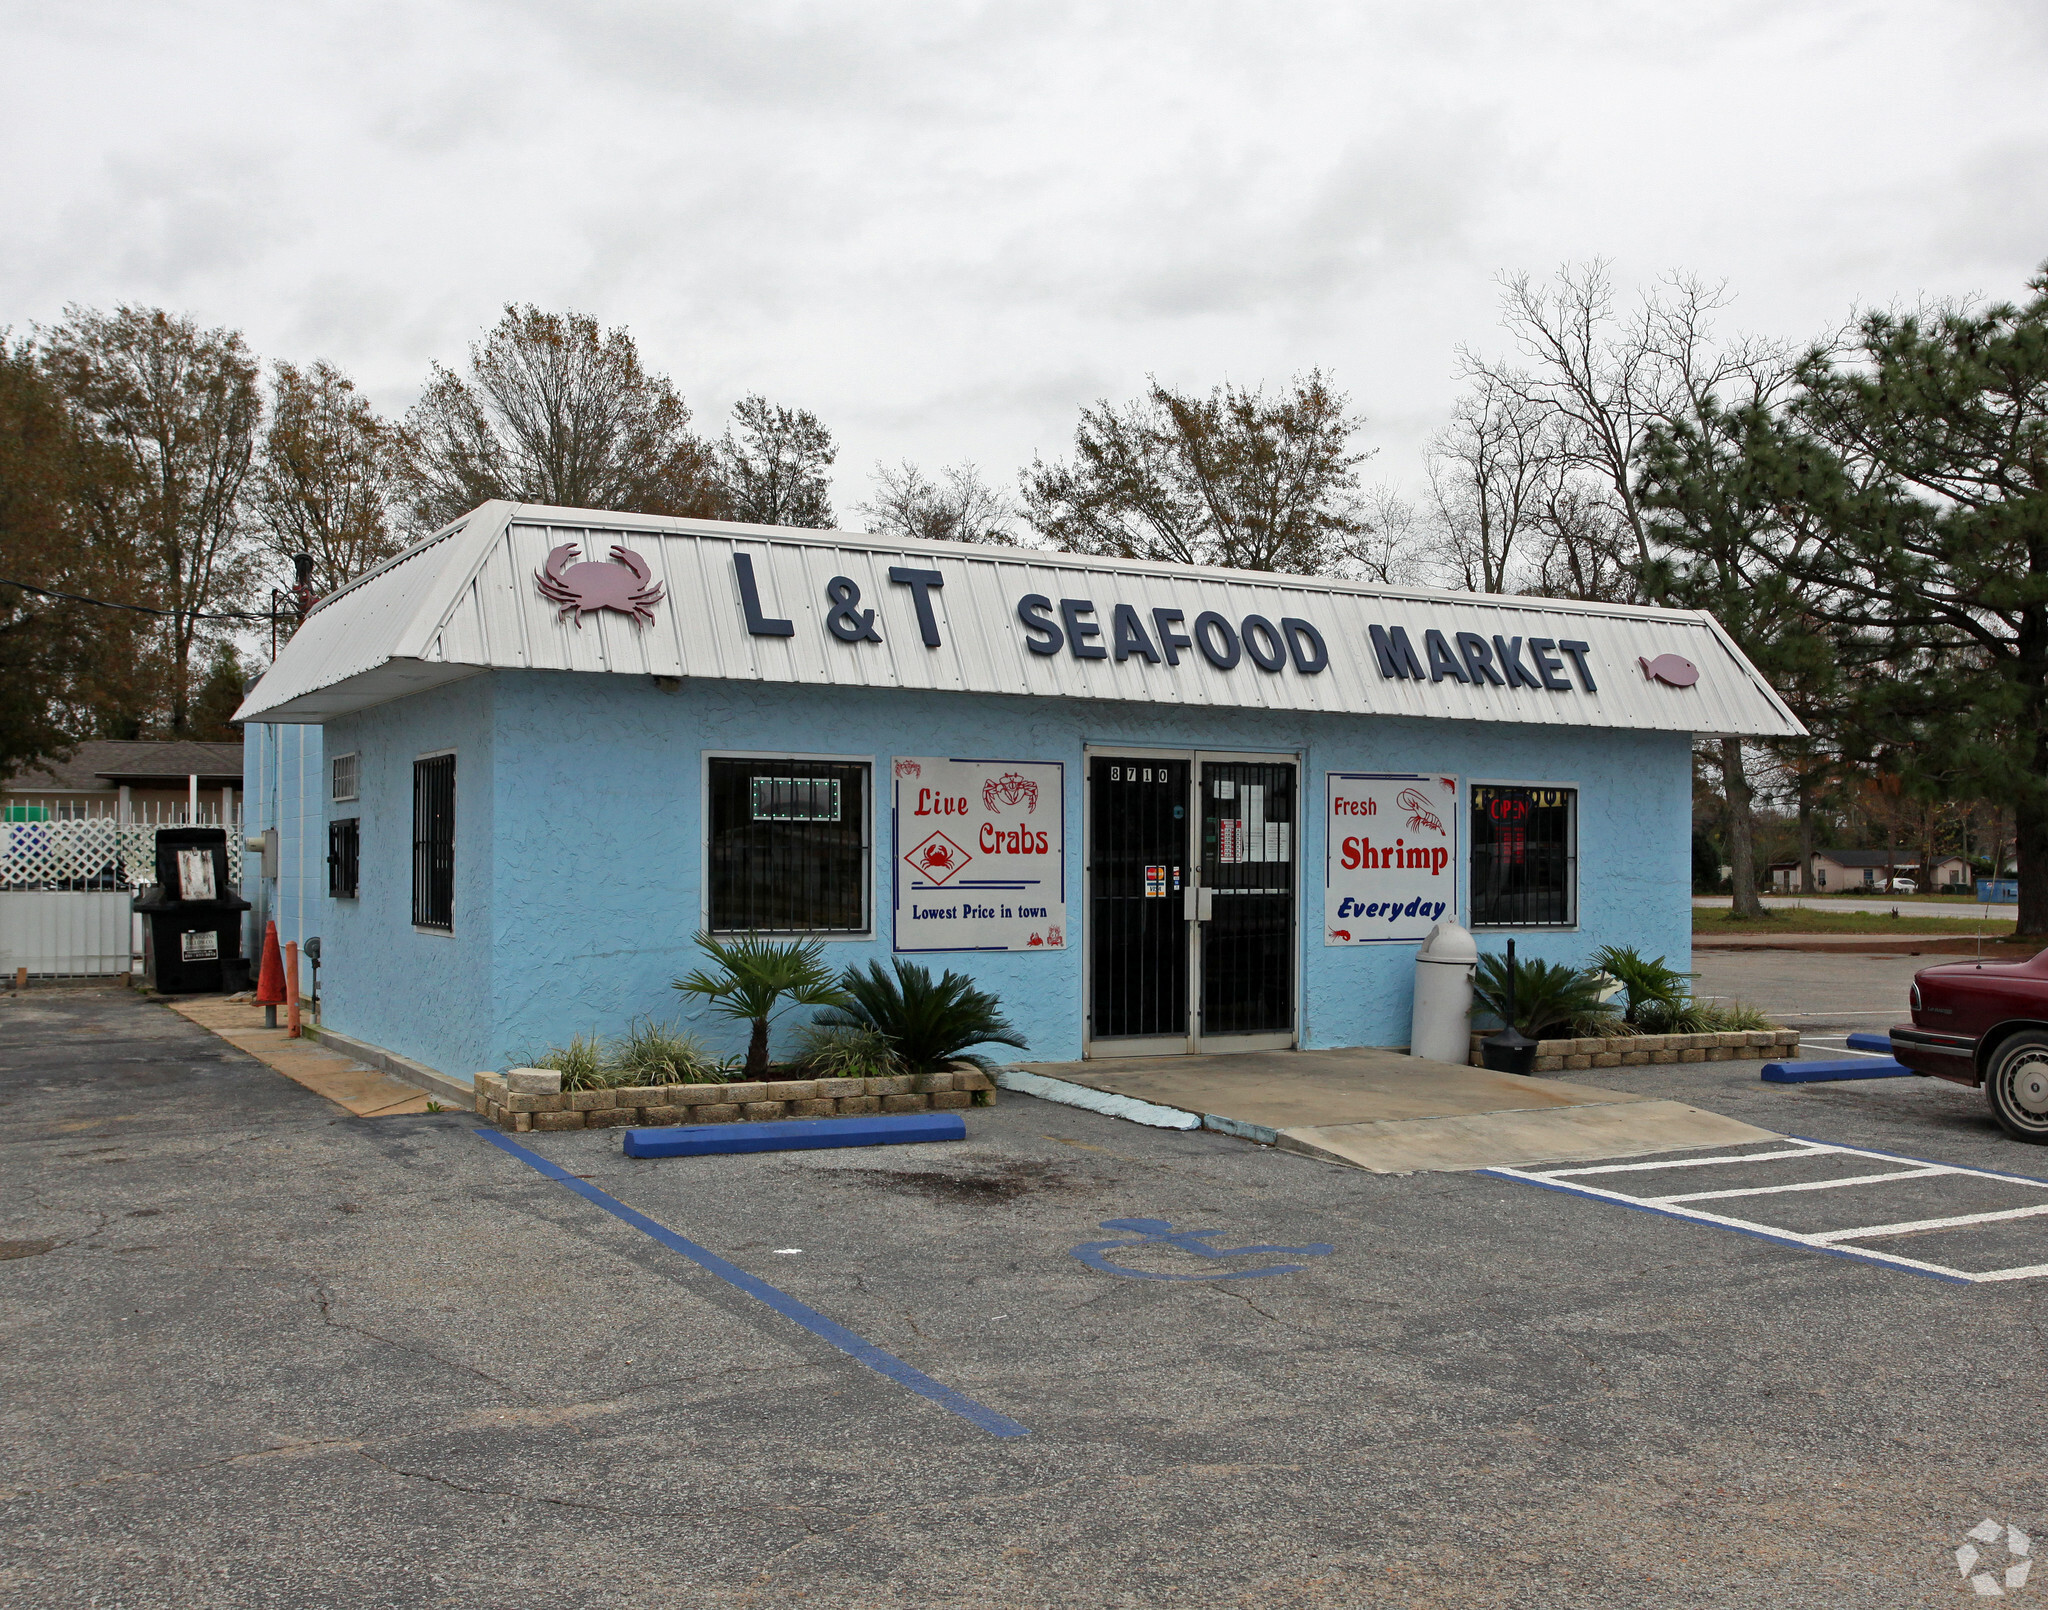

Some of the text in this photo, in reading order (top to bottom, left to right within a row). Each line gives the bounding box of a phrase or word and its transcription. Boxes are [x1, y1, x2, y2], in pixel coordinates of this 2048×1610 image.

[1018, 593, 1329, 674] SEAFOOD
[1369, 624, 1598, 693] MARKET
[1112, 767, 1167, 782] 8710
[914, 788, 969, 816] Live
[1335, 797, 1377, 816] Fresh
[1491, 799, 1528, 819] OPEN
[979, 822, 1049, 854] Crabs
[1341, 836, 1448, 876] Shrimp
[912, 904, 1047, 920] Lowest Price in town
[1337, 896, 1446, 922] Everyday
